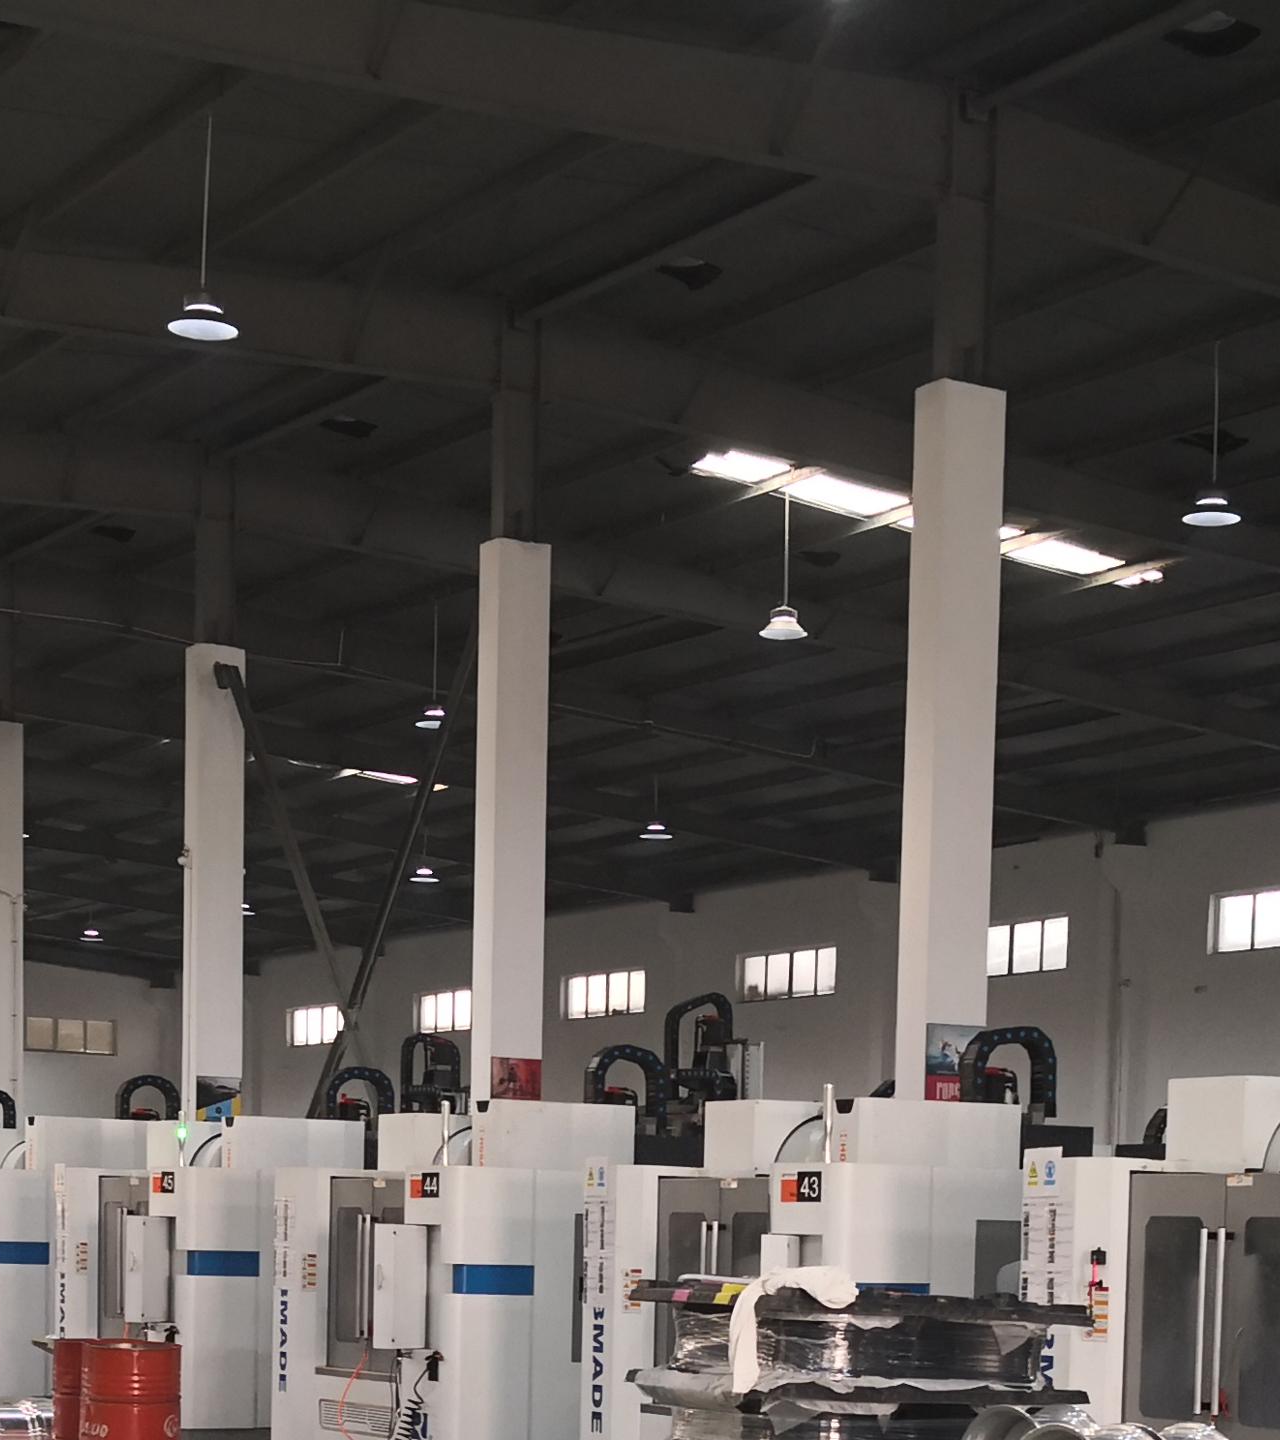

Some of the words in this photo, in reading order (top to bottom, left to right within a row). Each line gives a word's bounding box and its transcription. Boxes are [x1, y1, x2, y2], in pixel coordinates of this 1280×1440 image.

[162, 1175, 173, 1191] 45
[423, 1176, 438, 1194] 44
[800, 1176, 819, 1198] 43
